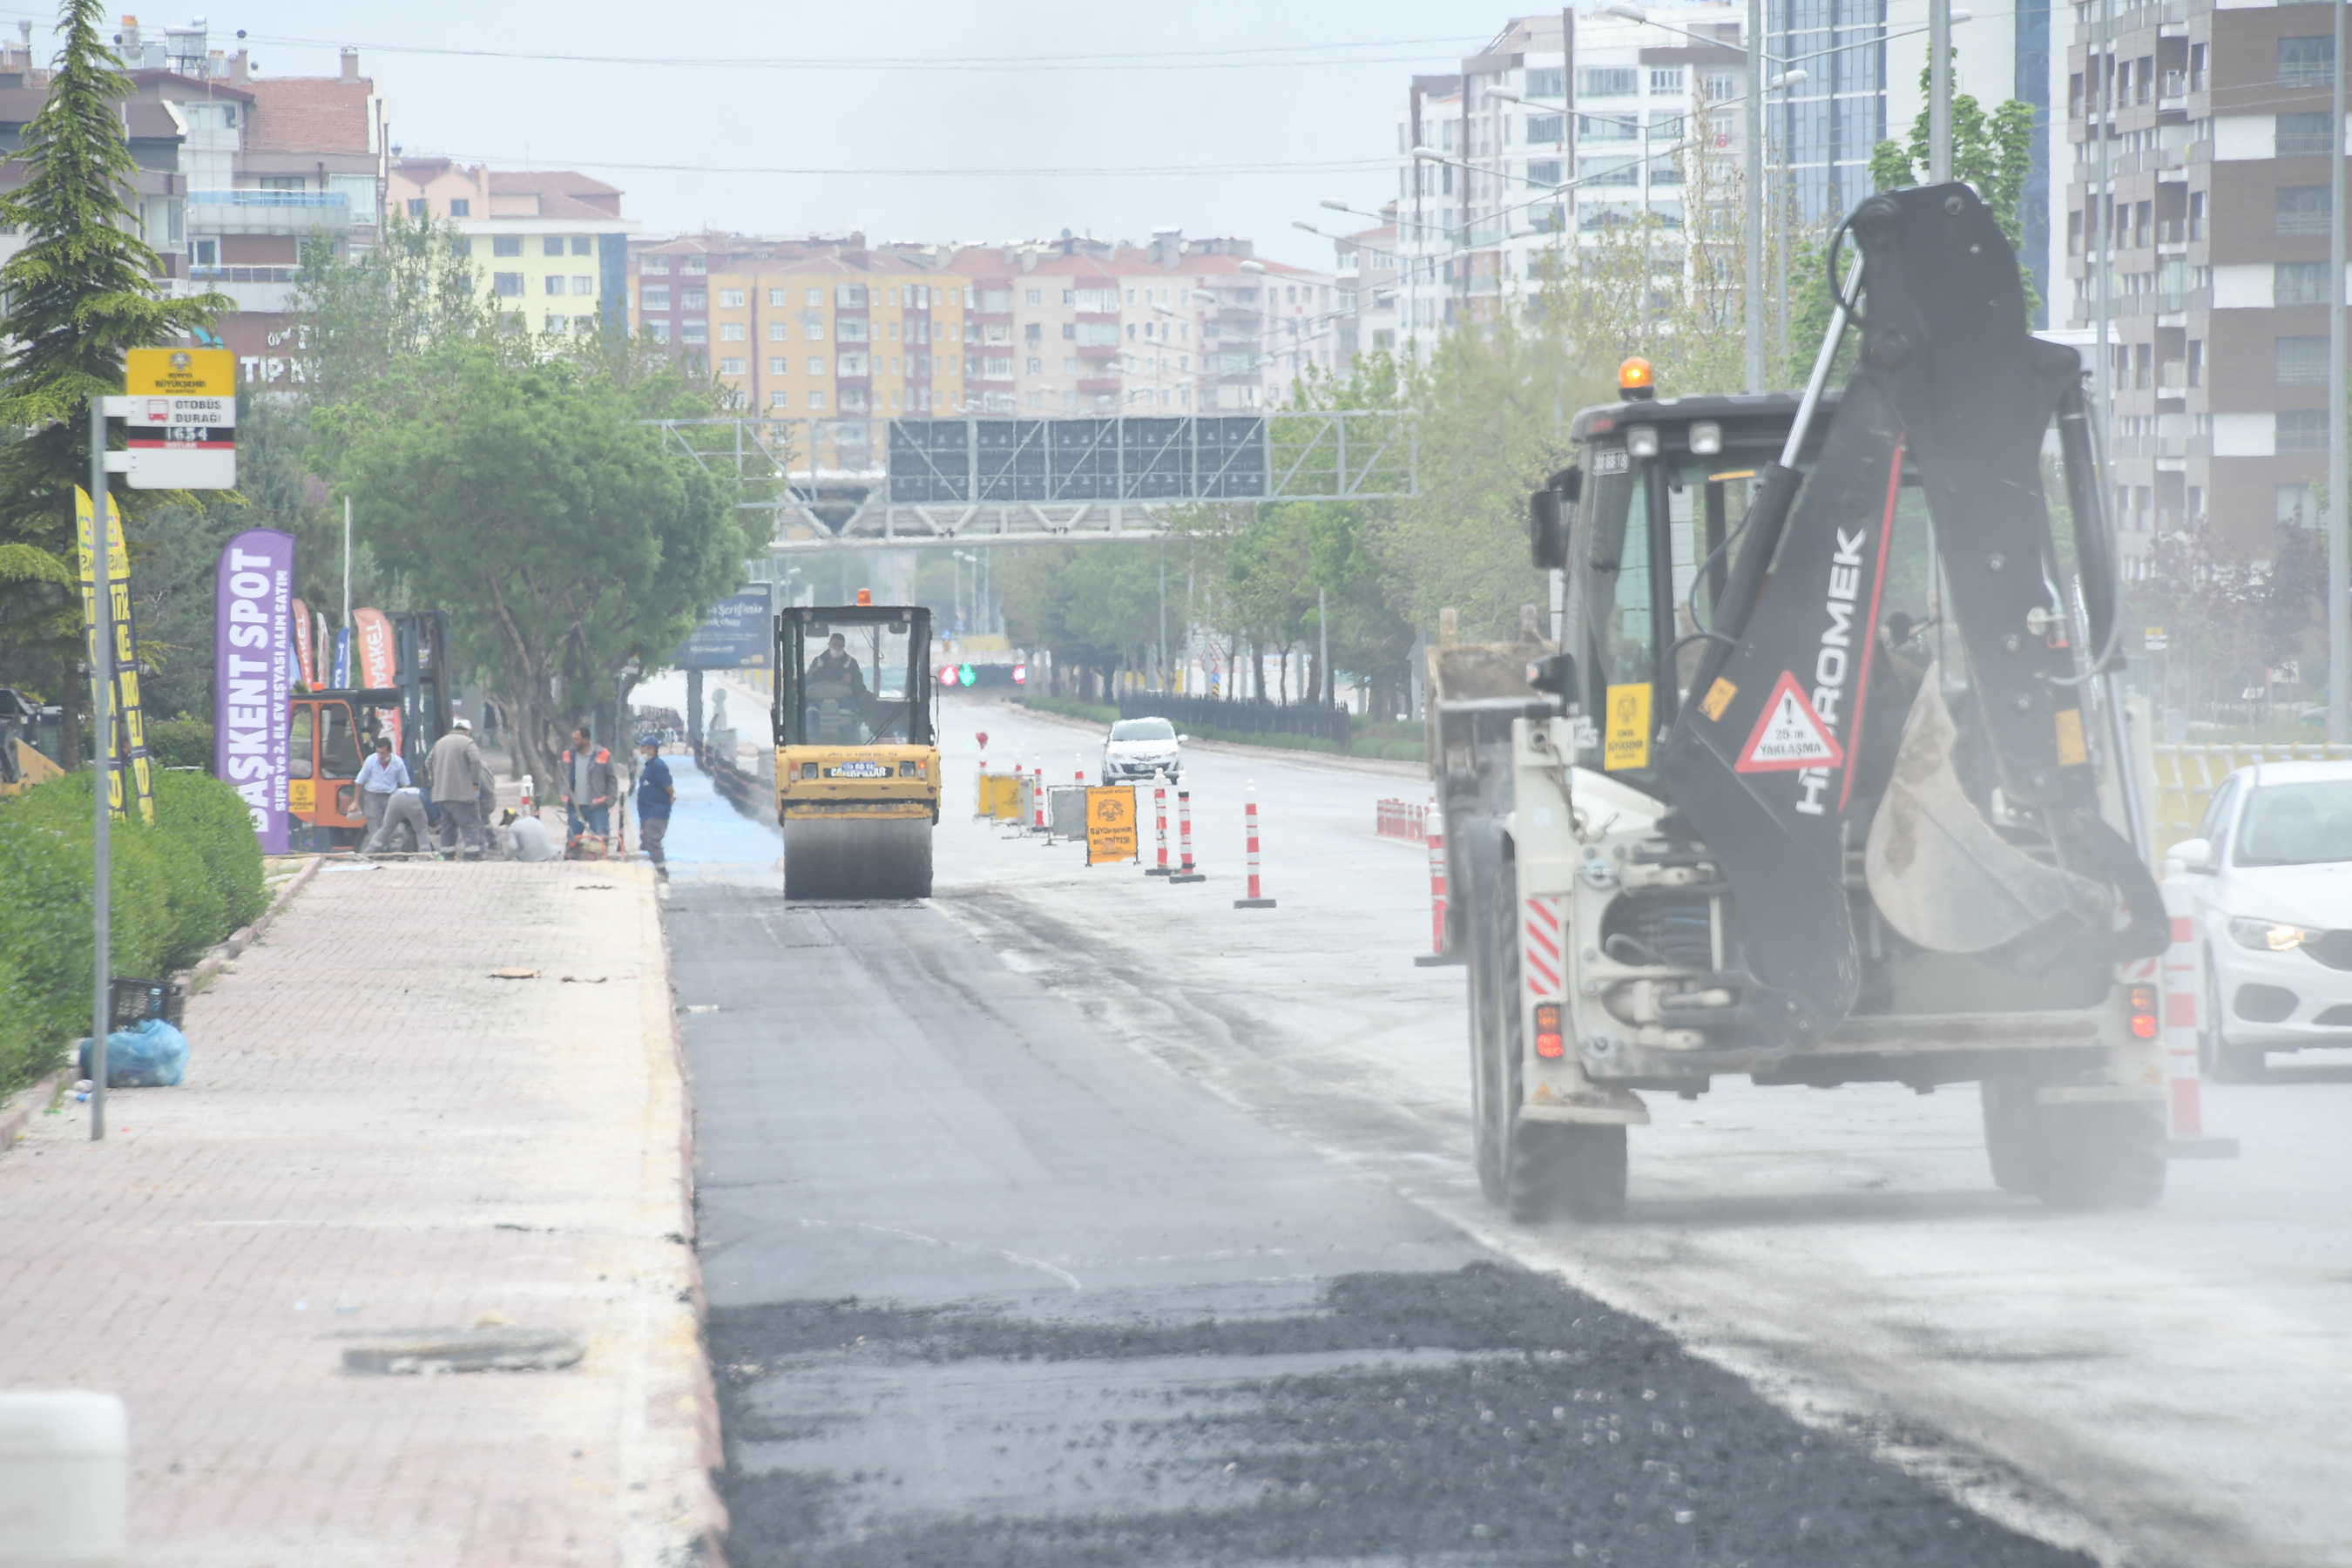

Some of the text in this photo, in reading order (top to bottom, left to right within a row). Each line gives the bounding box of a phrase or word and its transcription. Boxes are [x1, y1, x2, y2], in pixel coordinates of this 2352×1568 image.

[240, 356, 284, 383] TIP
[175, 398, 221, 409] OTOBÜS
[175, 411, 221, 423] DURAĞI
[166, 427, 208, 442] 1654
[229, 548, 271, 649] SPOT
[274, 614, 287, 649] ALIM
[274, 652, 287, 700] EŞYASI
[274, 702, 286, 721] EV
[274, 722, 286, 740] EL
[1775, 729, 1789, 740] 25
[274, 740, 285, 754] 2.
[1760, 743, 1821, 756] YAKLAŞMA
[276, 756, 287, 774] ve
[274, 775, 287, 812] SIFIR
